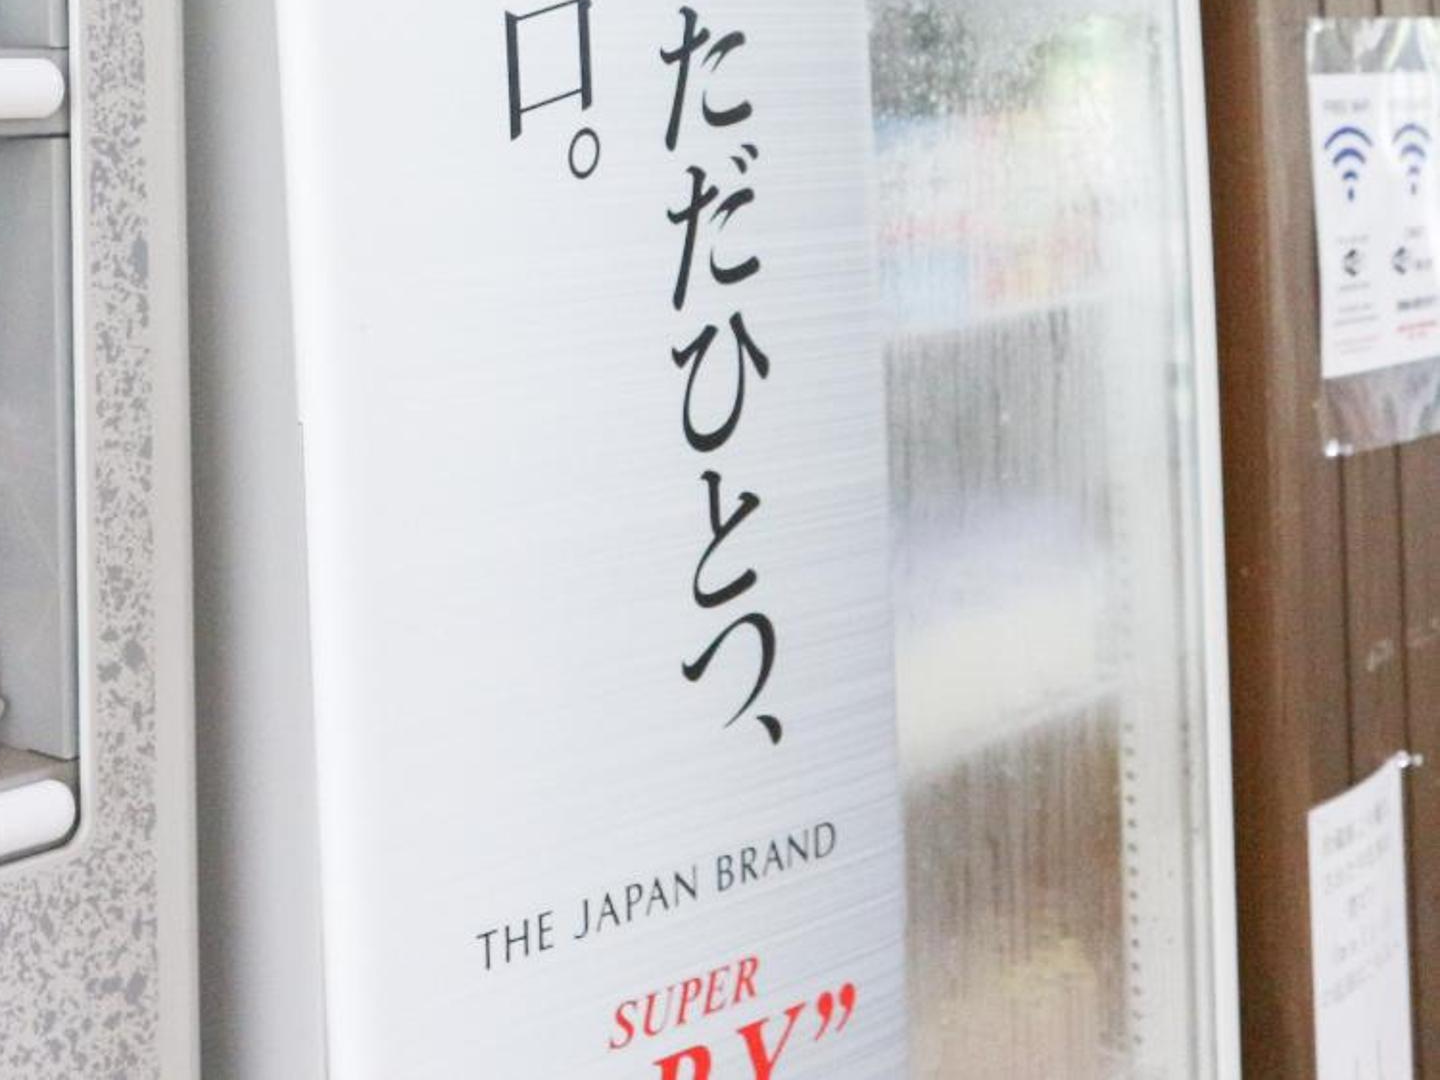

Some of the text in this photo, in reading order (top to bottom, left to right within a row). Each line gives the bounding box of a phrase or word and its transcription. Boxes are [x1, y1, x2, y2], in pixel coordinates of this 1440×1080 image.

[475, 821, 838, 971] THE JAPAN BRAND
[609, 955, 760, 1050] SUPER
